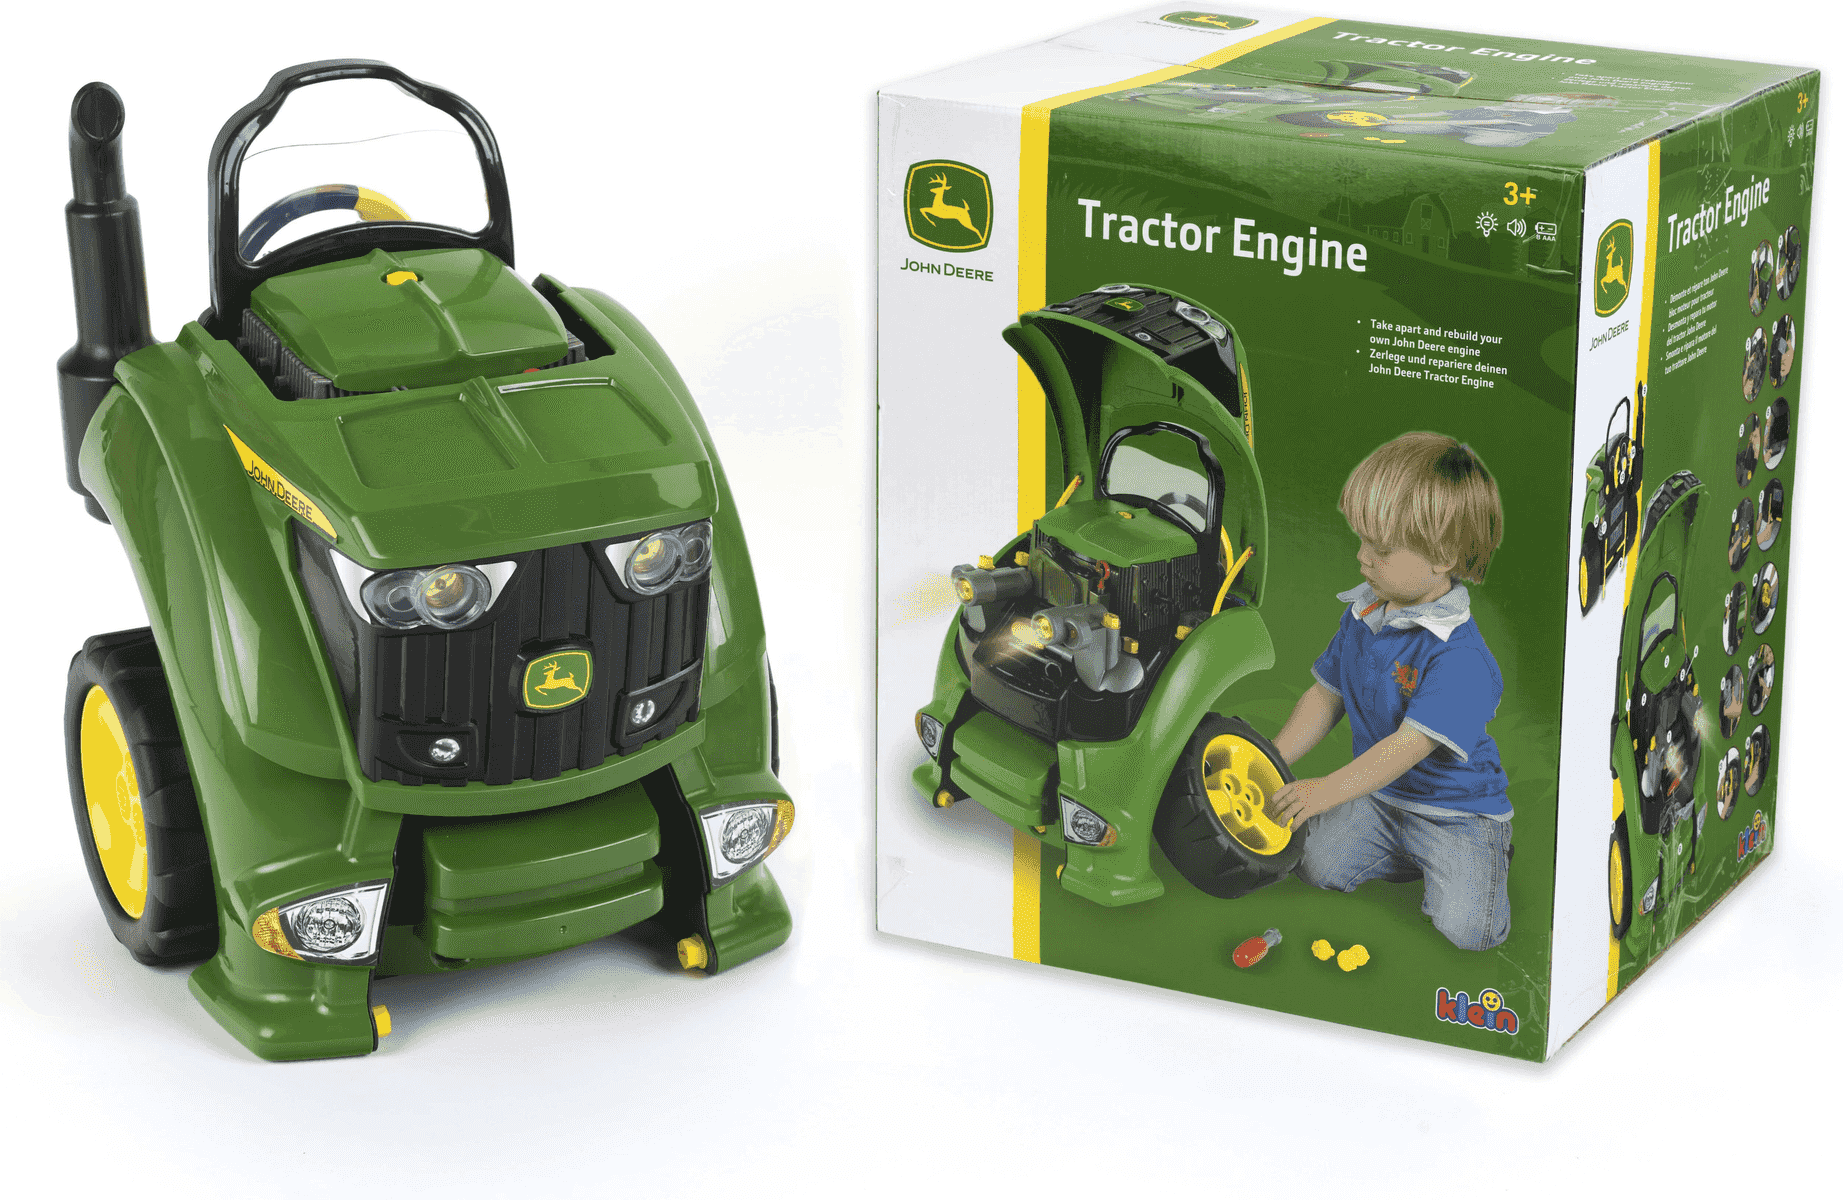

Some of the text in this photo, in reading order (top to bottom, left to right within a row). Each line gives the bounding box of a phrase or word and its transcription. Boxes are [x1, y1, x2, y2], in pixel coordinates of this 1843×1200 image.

[1333, 32, 1597, 65] Tractor Engine
[1797, 92, 1809, 113] 3+
[1503, 182, 1537, 205] 3+
[1668, 174, 1770, 253] Tractor Engine
[1078, 198, 1368, 277] Tractor Engine
[900, 258, 994, 282] JOHN DEERE
[1710, 272, 1718, 283] John
[1718, 267, 1728, 278] Deere
[1370, 318, 1502, 345] Take apart and rebuild your
[1589, 320, 1630, 352] JOHN DEERE
[1686, 325, 1696, 336] John
[1696, 320, 1706, 331] Deere
[1370, 336, 1480, 358] own John Deere engine
[1687, 352, 1696, 362] John
[1696, 346, 1708, 358] Deere
[1370, 348, 1508, 375] Zerlege und repariere deinen
[1368, 363, 1494, 389] John Deere Tractor Engine
[247, 460, 313, 521] JOHN DEERE
[1738, 810, 1766, 862] klein
[1436, 987, 1519, 1035] klein
